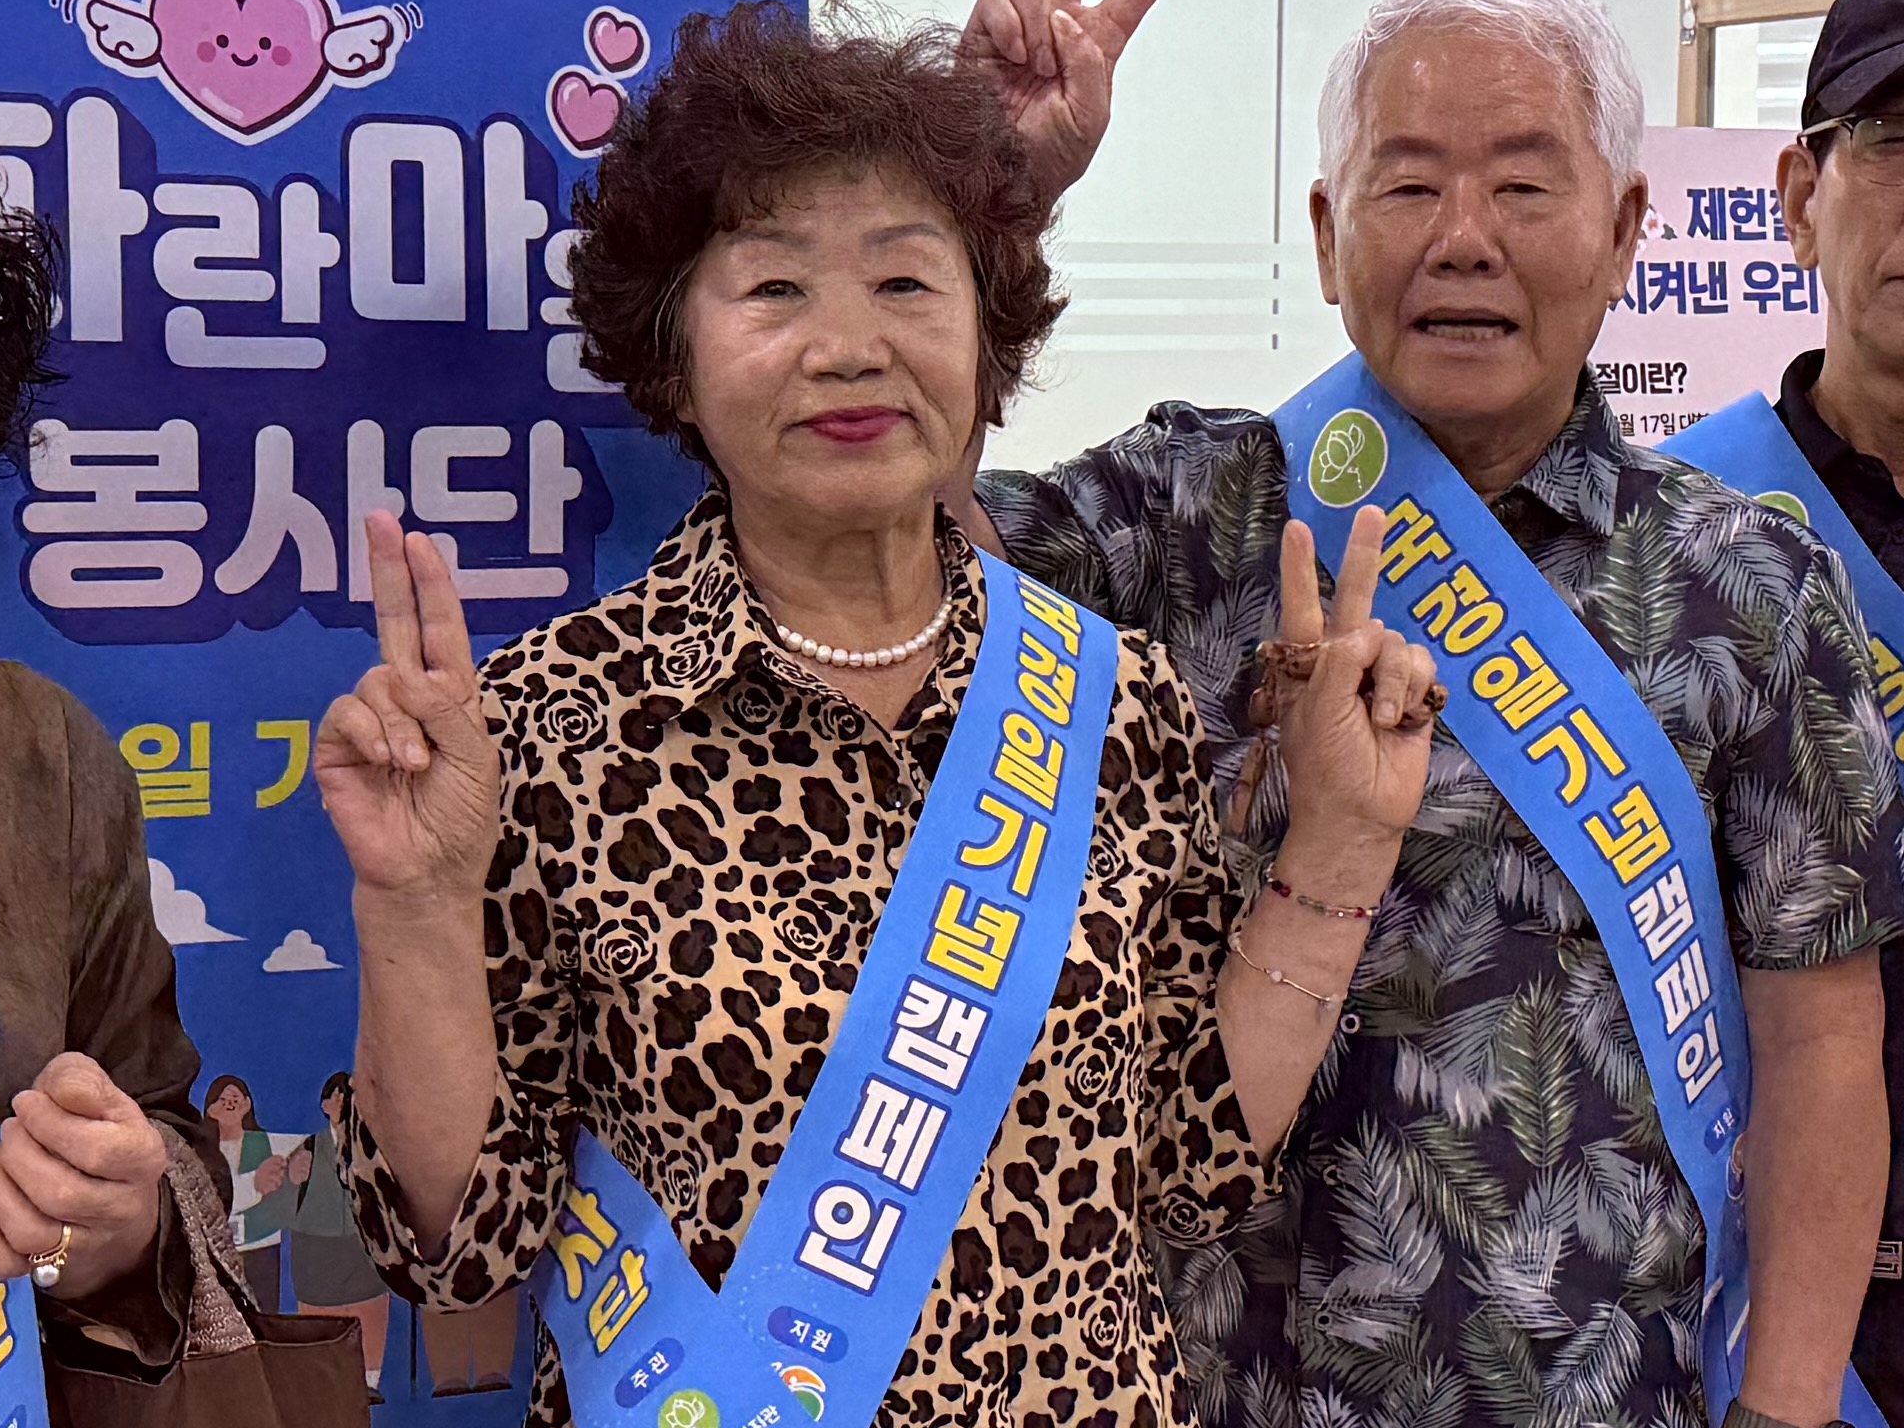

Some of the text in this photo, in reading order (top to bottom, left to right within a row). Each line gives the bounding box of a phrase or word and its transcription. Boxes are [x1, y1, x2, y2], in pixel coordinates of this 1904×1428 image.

[1743, 261, 1819, 315] 우리
[1615, 413, 1635, 437] 월
[1640, 412, 1676, 436] 17일
[23, 419, 583, 608] 봉사단
[1379, 498, 1724, 1104] 국경일기념캠페인
[799, 574, 1082, 1293] 국경일기념캠페인
[790, 1318, 832, 1353] 지원
[630, 1351, 669, 1391] 주관
